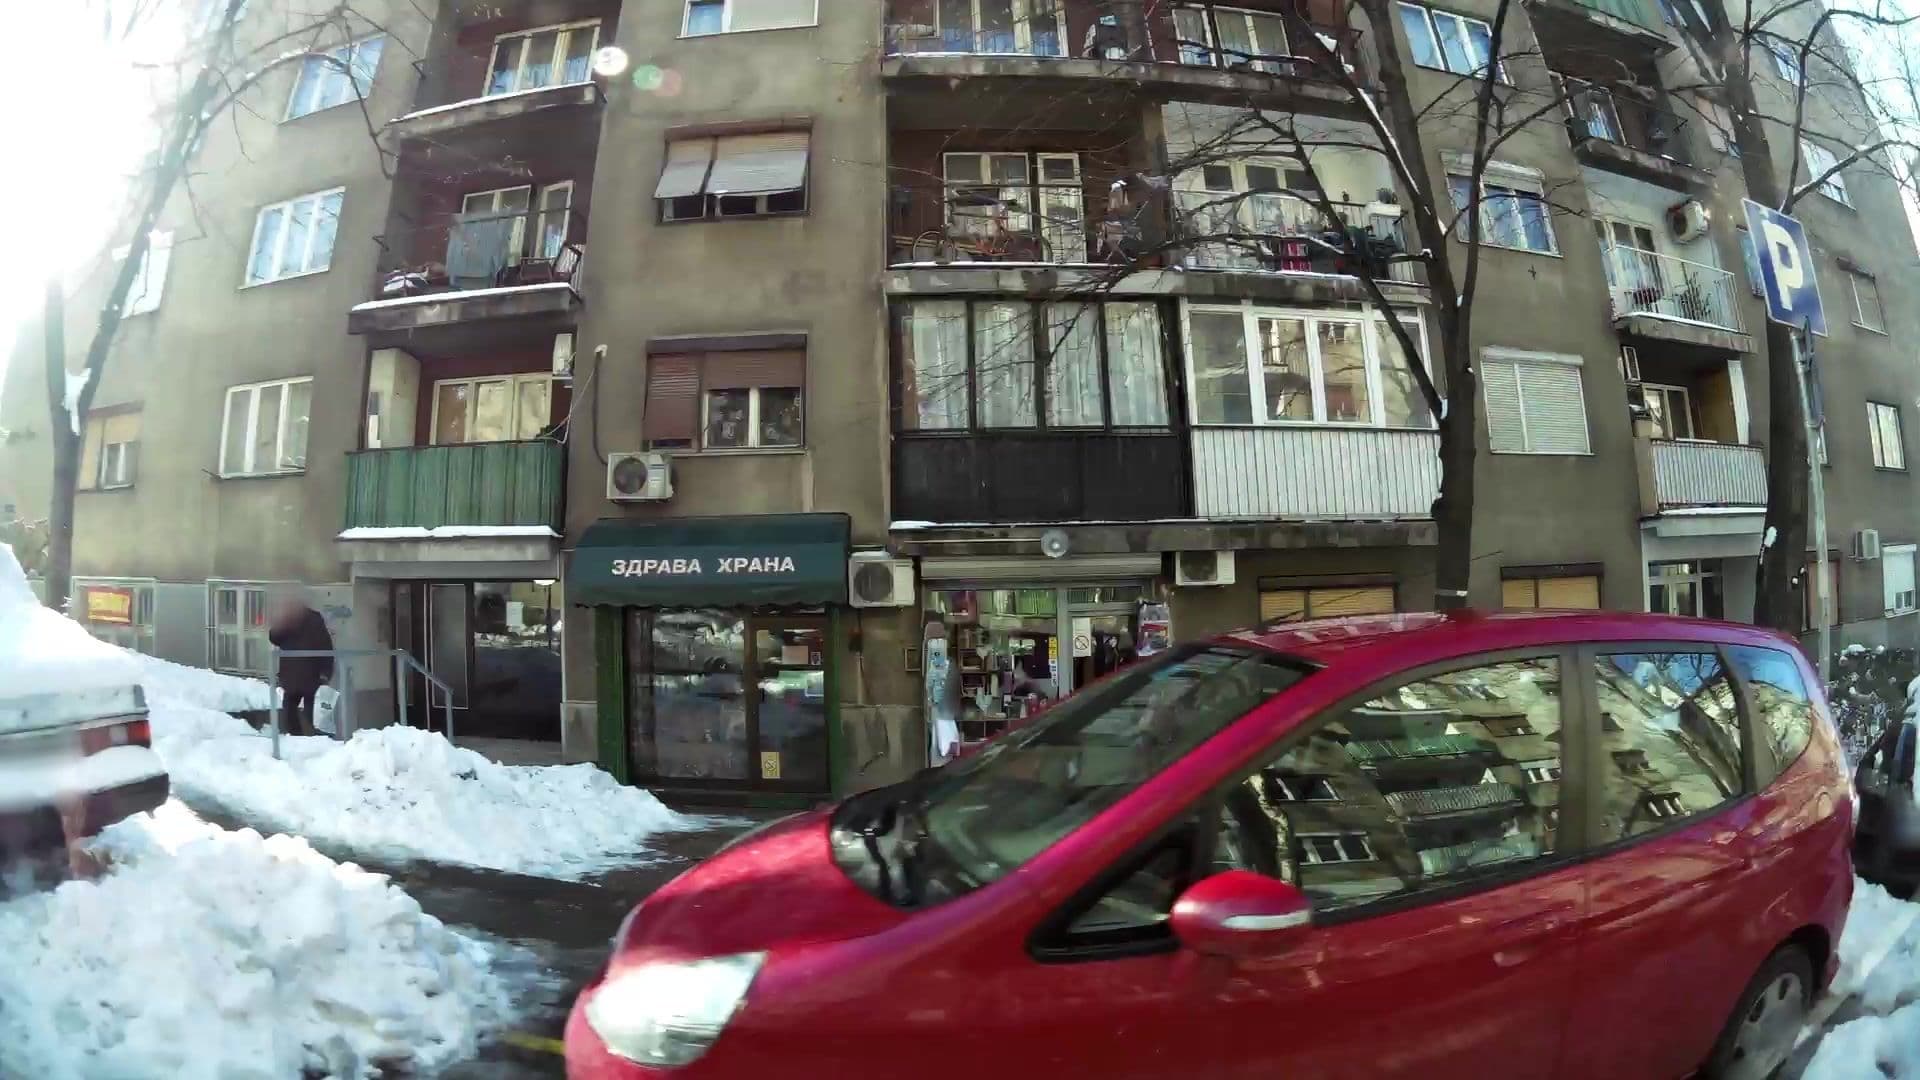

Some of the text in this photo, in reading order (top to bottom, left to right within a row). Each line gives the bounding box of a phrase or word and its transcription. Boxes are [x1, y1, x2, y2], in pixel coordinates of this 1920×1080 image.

[1761, 220, 1803, 311] P
[611, 556, 796, 577] ЗДРАВА ХРАНА
